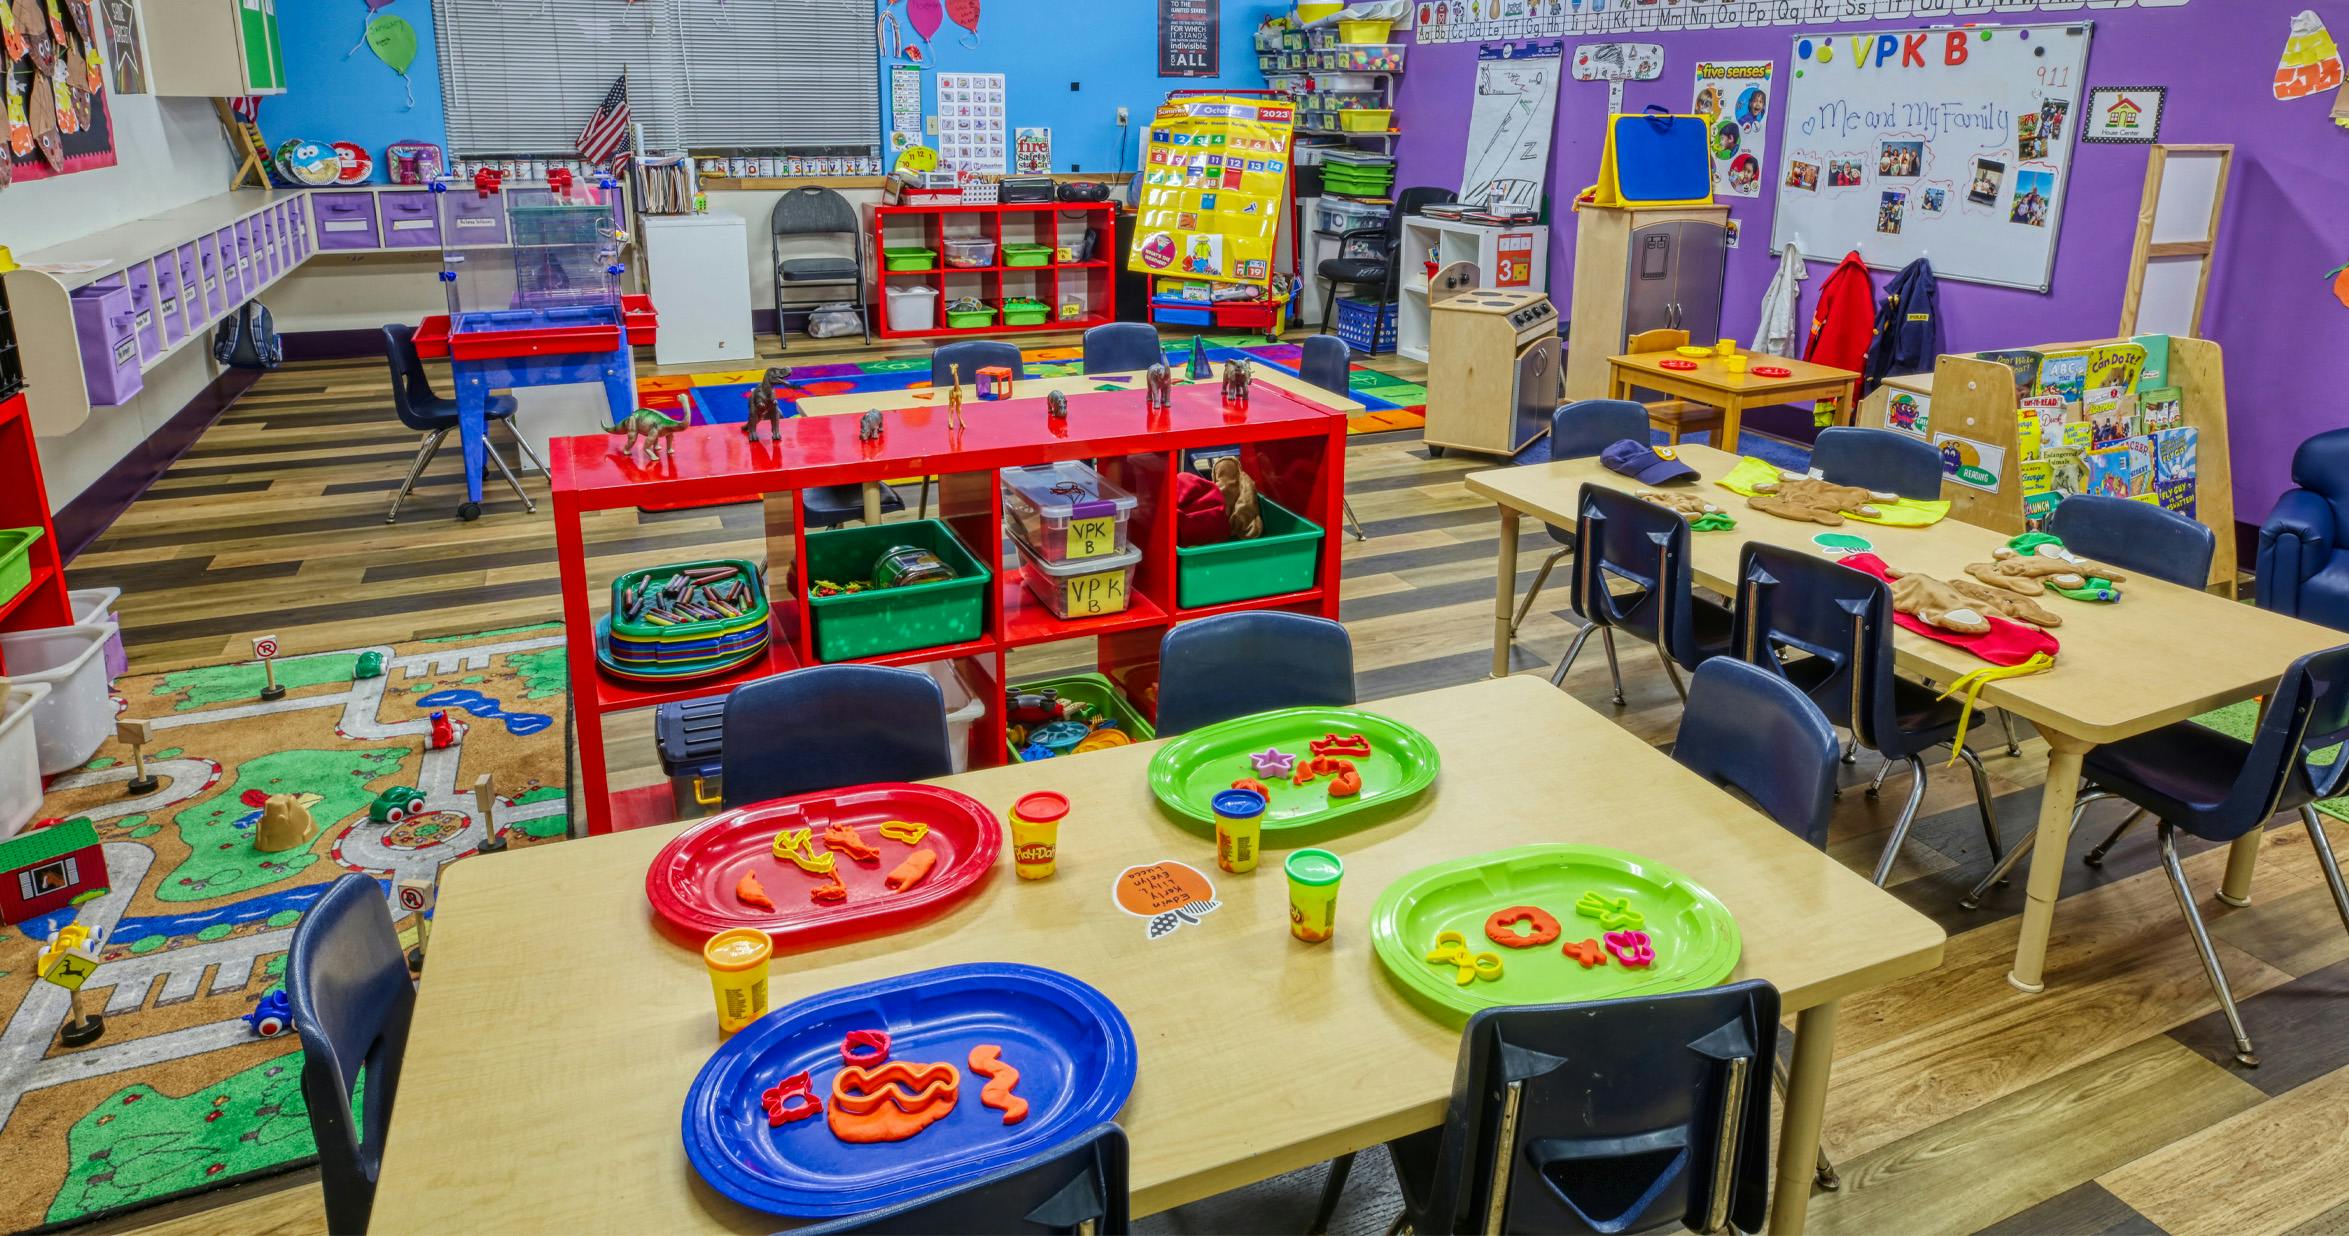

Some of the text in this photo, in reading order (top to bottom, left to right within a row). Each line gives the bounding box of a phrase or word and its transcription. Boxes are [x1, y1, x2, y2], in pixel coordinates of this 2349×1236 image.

[1418, 29, 1431, 41] Aa
[1434, 28, 1446, 40] Bb
[1451, 26, 1463, 39] Cc
[1469, 25, 1481, 38] Dd
[1487, 23, 1500, 36] Ee
[1507, 21, 1518, 35] Ff
[1526, 19, 1540, 37] Gg
[1546, 18, 1560, 32] Hh
[1570, 16, 1579, 31] Ii
[1591, 13, 1604, 34] Jj
[1613, 11, 1628, 29] Kk
[1639, 10, 1651, 27] Ll
[1659, 7, 1683, 26] Mm
[1690, 7, 1707, 25] Nn
[1718, 4, 1737, 24] Oo
[1748, 2, 1766, 26] Pp
[1778, 0, 1800, 26] Qq
[1812, 0, 1831, 18] Rr
[1845, 0, 1866, 15] Ss
[1184, 25, 1207, 33] WHICH
[1851, 31, 1969, 68] VPK B
[1176, 53, 1208, 67] ALL
[1702, 63, 1766, 79] five senses
[2036, 65, 2070, 88] 911
[1203, 106, 1243, 116] October
[1819, 99, 2009, 149] Me and My Family
[2101, 128, 2140, 136] House Center
[1018, 138, 1048, 153] fire
[1178, 135, 1186, 143] 2
[1214, 135, 1222, 143] 4
[1254, 141, 1261, 149] 6
[917, 150, 924, 158] 12
[1018, 152, 1048, 162] safety
[1155, 154, 1162, 162] 8
[1211, 156, 1220, 164] 11
[1230, 159, 1241, 167] 12
[1250, 161, 1262, 170] 13
[1268, 161, 1281, 170] 14
[1499, 259, 1513, 282] 3
[2091, 359, 2111, 374] Can
[2111, 352, 2124, 365] Do
[2124, 351, 2142, 366] It!
[2043, 450, 2079, 459] Endangered
[1962, 468, 1990, 483] READING
[2160, 482, 2187, 501] FLY GUY
[1072, 521, 1106, 540] VPK
[1085, 540, 1095, 554] B
[1071, 577, 1122, 603] VPK
[1088, 599, 1101, 613] B
[1014, 845, 1057, 860] Play-Doh
[1127, 866, 1163, 879] Lucca
[1133, 870, 1170, 887] Evelyn
[1150, 879, 1175, 890] Lily
[1150, 885, 1183, 901] Karly
[1152, 892, 1191, 908] Edwin
